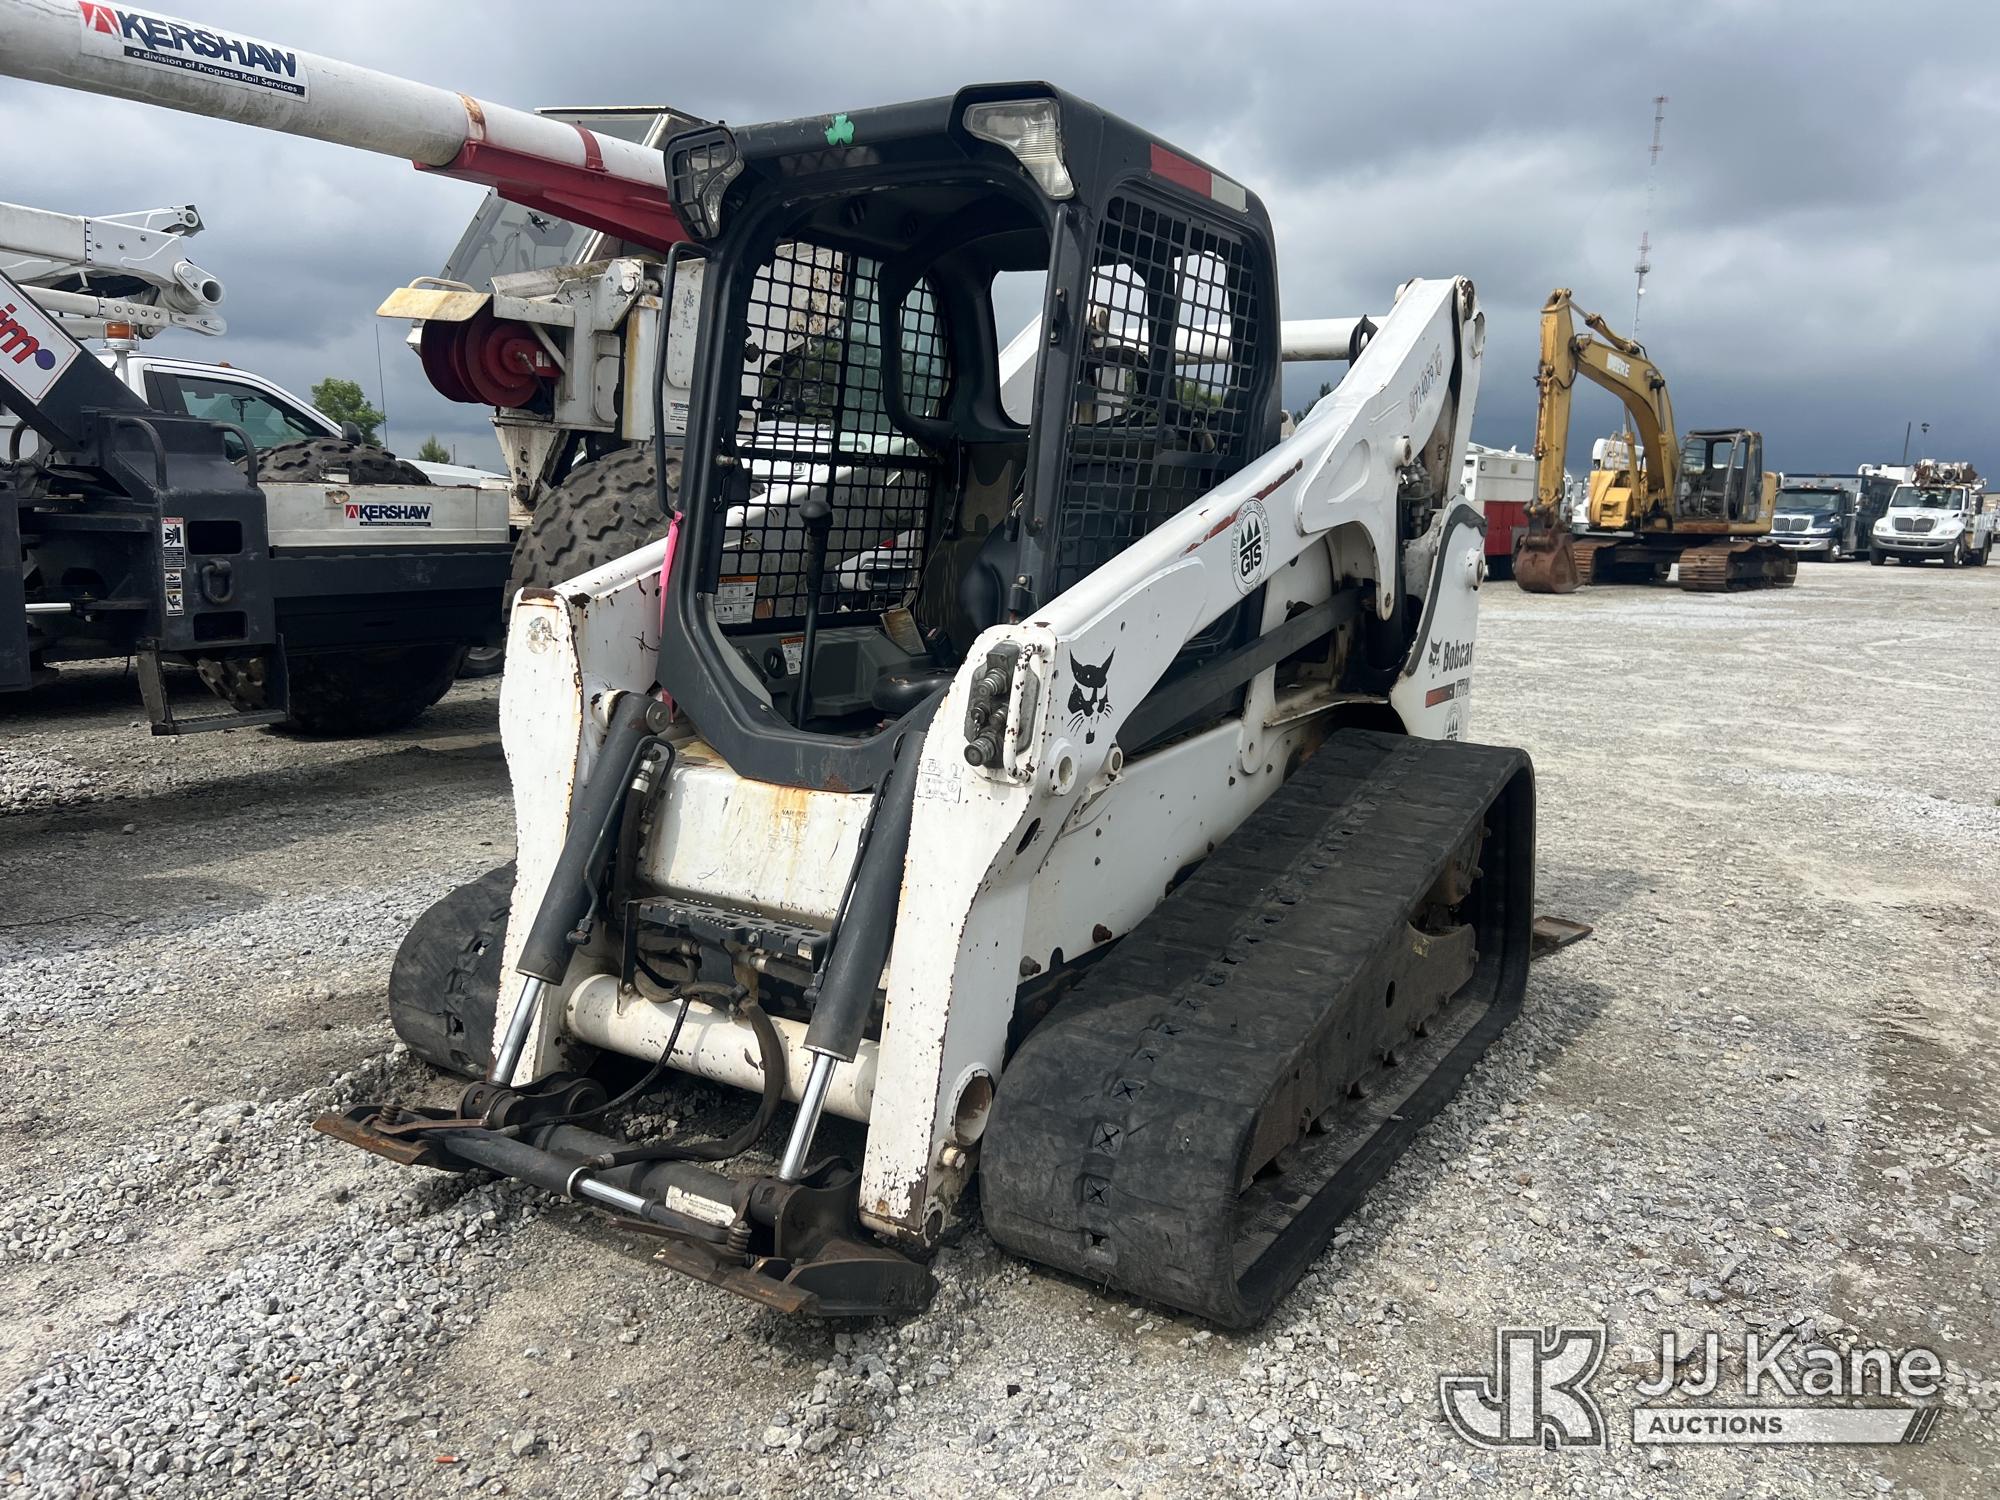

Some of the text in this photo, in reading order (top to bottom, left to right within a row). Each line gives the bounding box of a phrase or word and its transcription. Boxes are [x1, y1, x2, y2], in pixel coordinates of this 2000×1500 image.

[115, 10, 297, 78] KERSHAW
[143, 52, 183, 67] division
[185, 60, 197, 70] of
[198, 63, 239, 80] Progress
[241, 72, 259, 84] Rail
[261, 77, 298, 94] Services
[360, 505, 431, 521] KERSHAW
[1240, 538, 1262, 577] GTS
